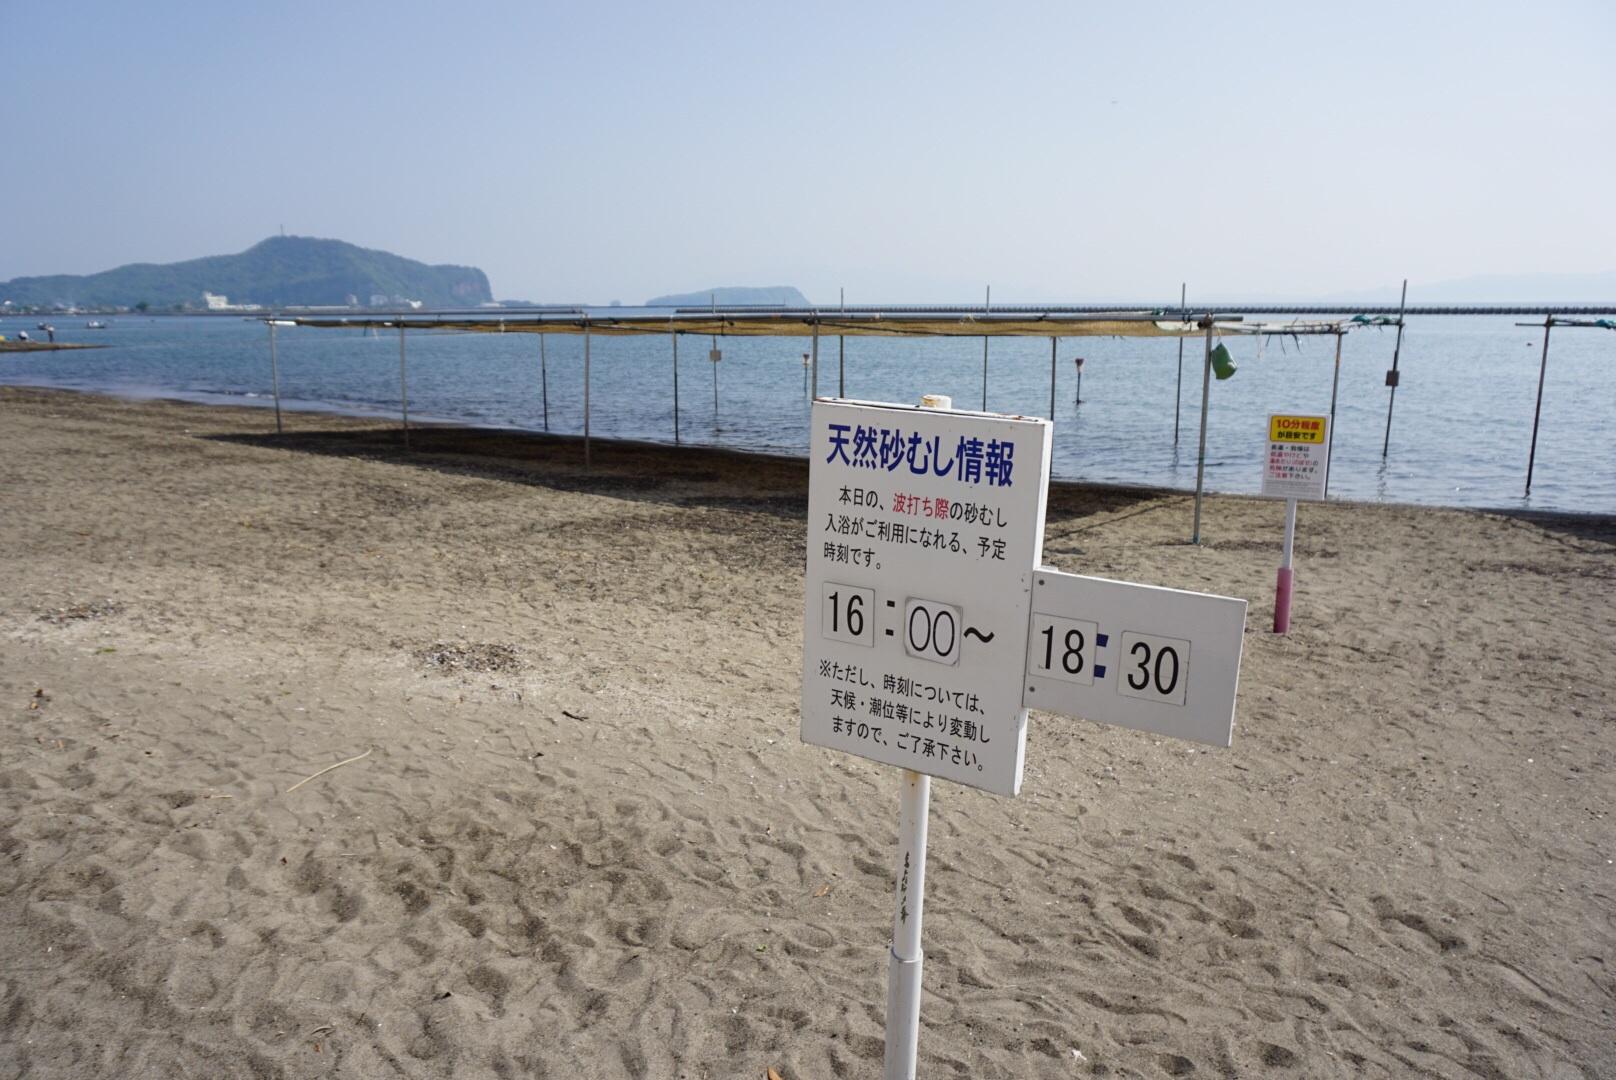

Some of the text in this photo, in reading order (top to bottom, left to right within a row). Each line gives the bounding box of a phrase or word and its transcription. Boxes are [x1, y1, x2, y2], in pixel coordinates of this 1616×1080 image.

[826, 423, 1015, 487] 天然砂むし情報
[839, 485, 1008, 528] 本日の、波打ち際の砂むし
[824, 541, 882, 570] 時刻です。
[825, 514, 1007, 560] 入浴がご利用になれる、予定
[831, 688, 991, 744] 天候・潮位等により変動し
[832, 715, 984, 772] ますので、ご了承下さい。
